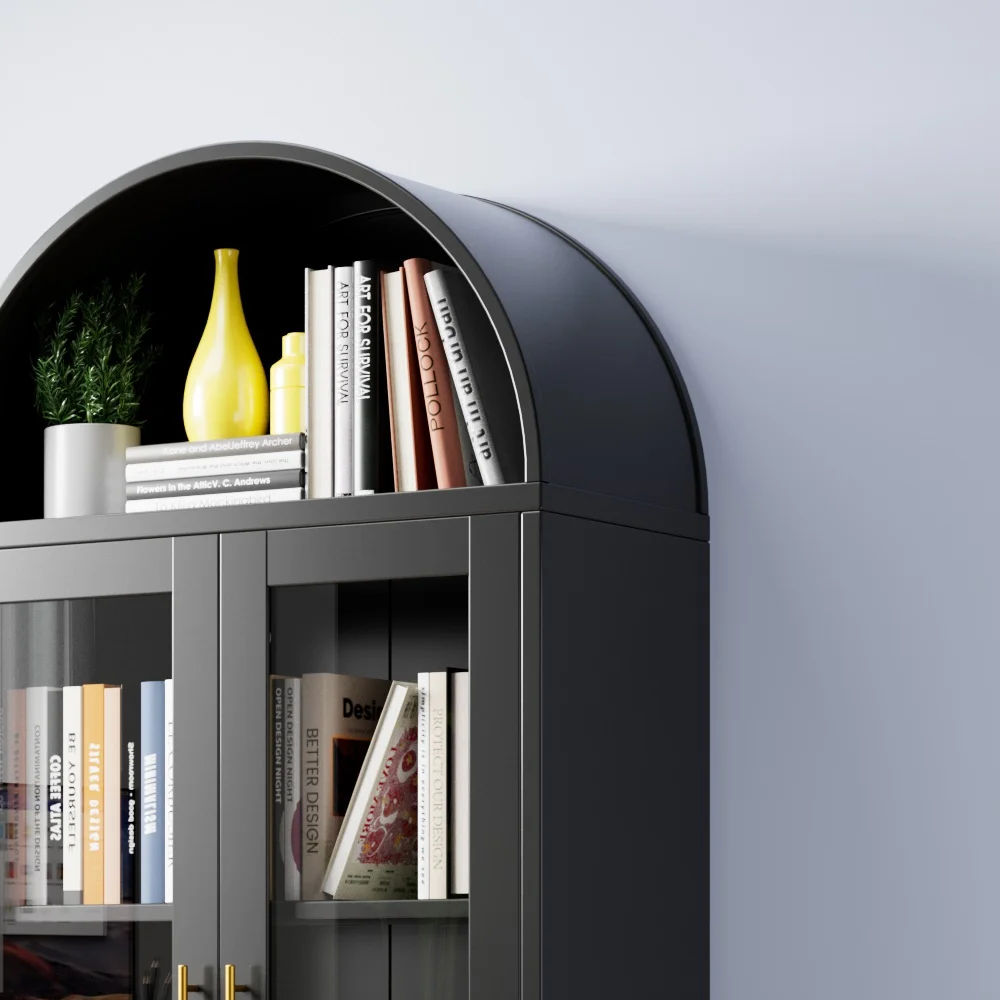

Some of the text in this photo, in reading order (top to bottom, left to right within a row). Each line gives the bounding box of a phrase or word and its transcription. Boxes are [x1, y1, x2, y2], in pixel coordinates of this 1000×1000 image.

[339, 281, 349, 405] ART FOR SURVIVAL
[357, 274, 371, 401] ART FOR SURVIVAL
[414, 322, 444, 432] POLLOCK
[136, 485, 167, 494] Flowers
[168, 484, 177, 492] in
[178, 482, 191, 491] the
[233, 476, 271, 487] Andrews
[262, 436, 293, 447] Archer
[306, 728, 318, 853] BETTER DESIGN
[433, 708, 444, 871] PROTECT OUR DESIGN
